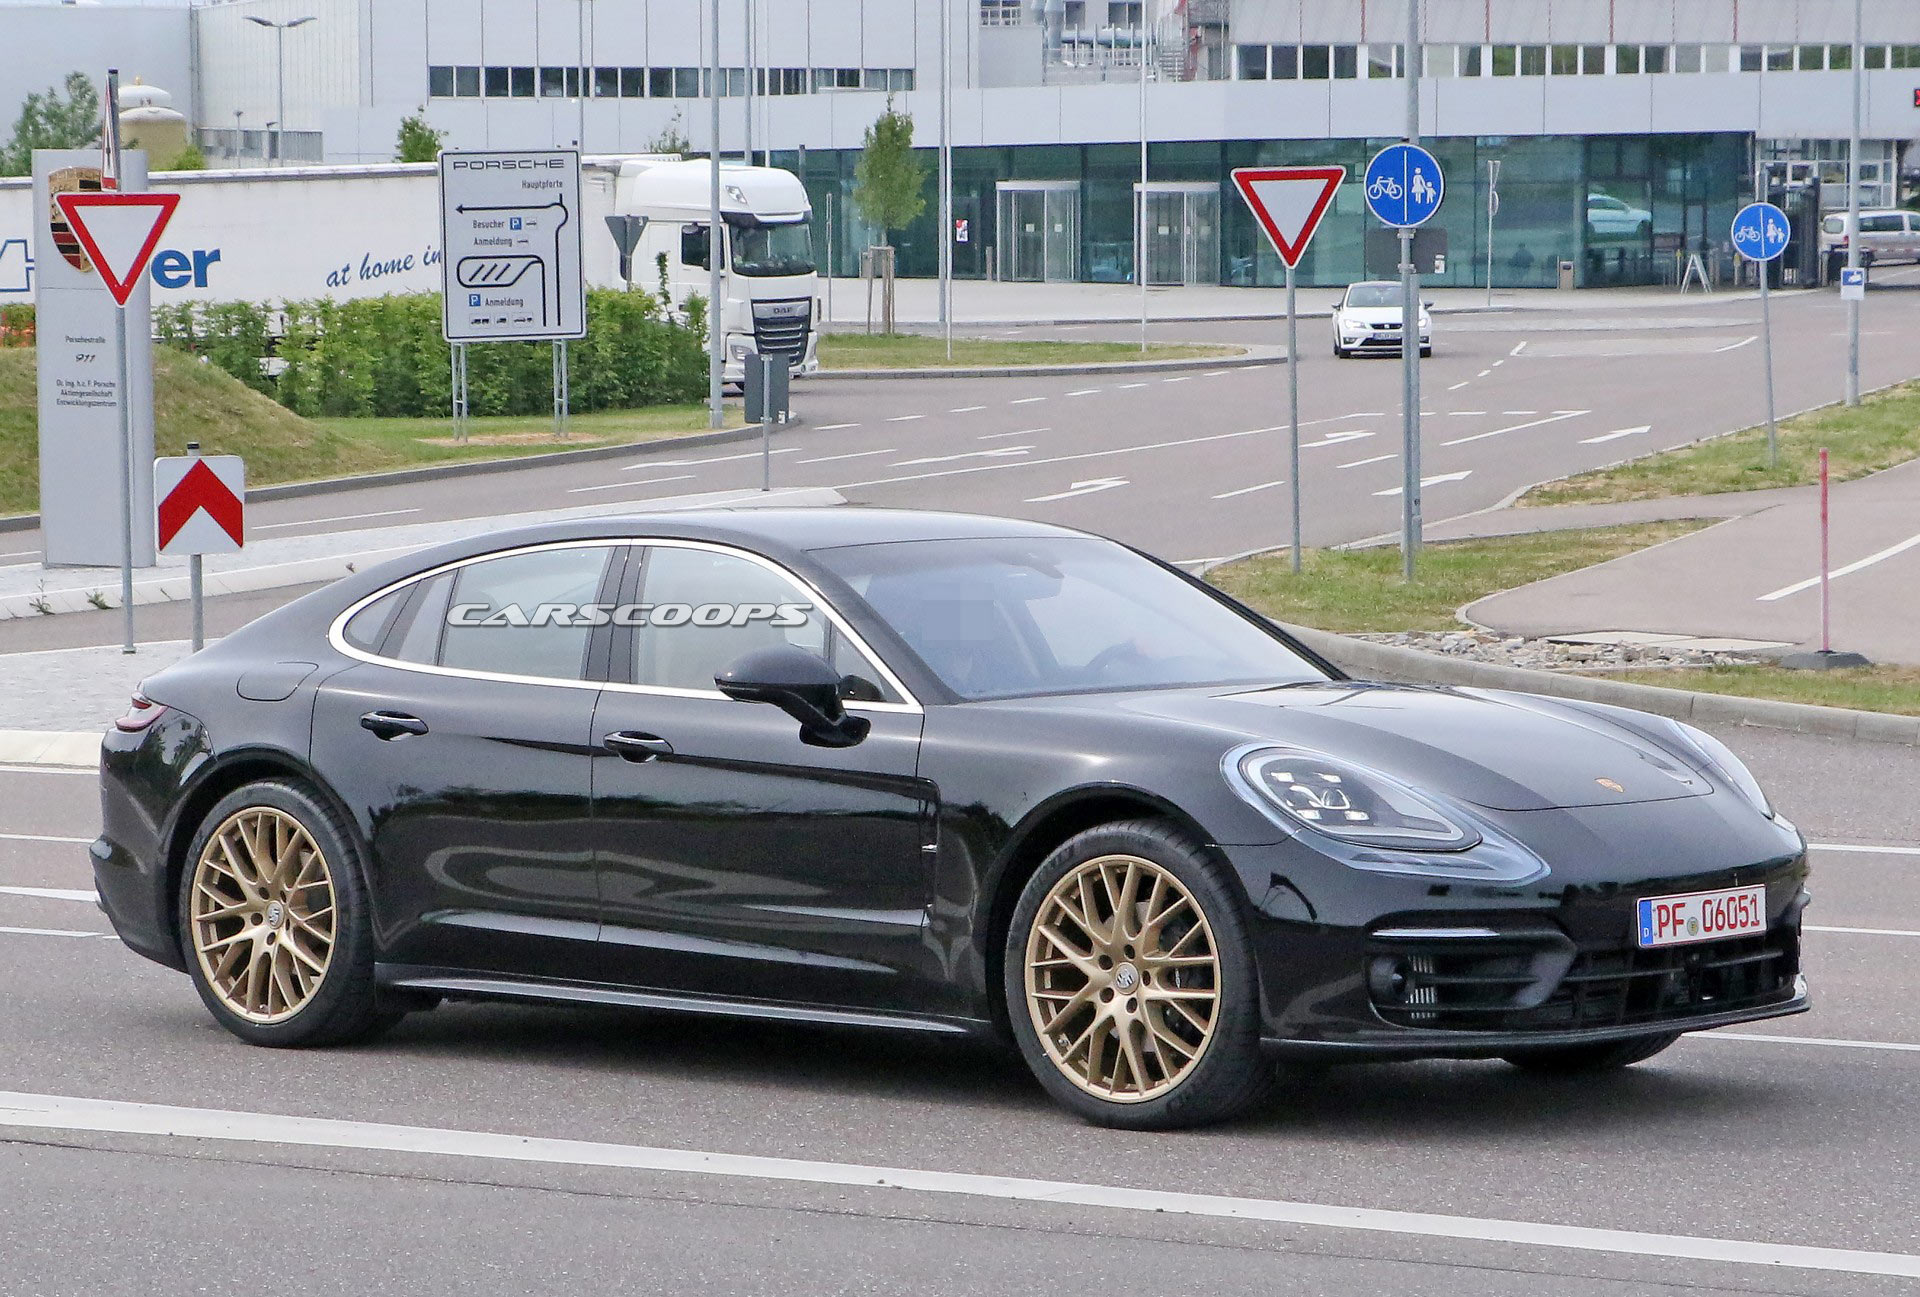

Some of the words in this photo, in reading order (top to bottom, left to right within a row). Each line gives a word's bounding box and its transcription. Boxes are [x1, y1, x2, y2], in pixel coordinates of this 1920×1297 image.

[453, 159, 564, 170] PORSCHE
[521, 179, 563, 190] Hauptpforte
[472, 219, 505, 229] Besucher
[473, 237, 513, 247] Anmeldung
[326, 263, 351, 288] at
[359, 252, 415, 280] home
[484, 298, 524, 308] Anmeldung
[75, 353, 96, 363] 911
[93, 380, 116, 388] Porsche
[1656, 902, 1686, 938] PF
[1702, 893, 1760, 933] 06051
